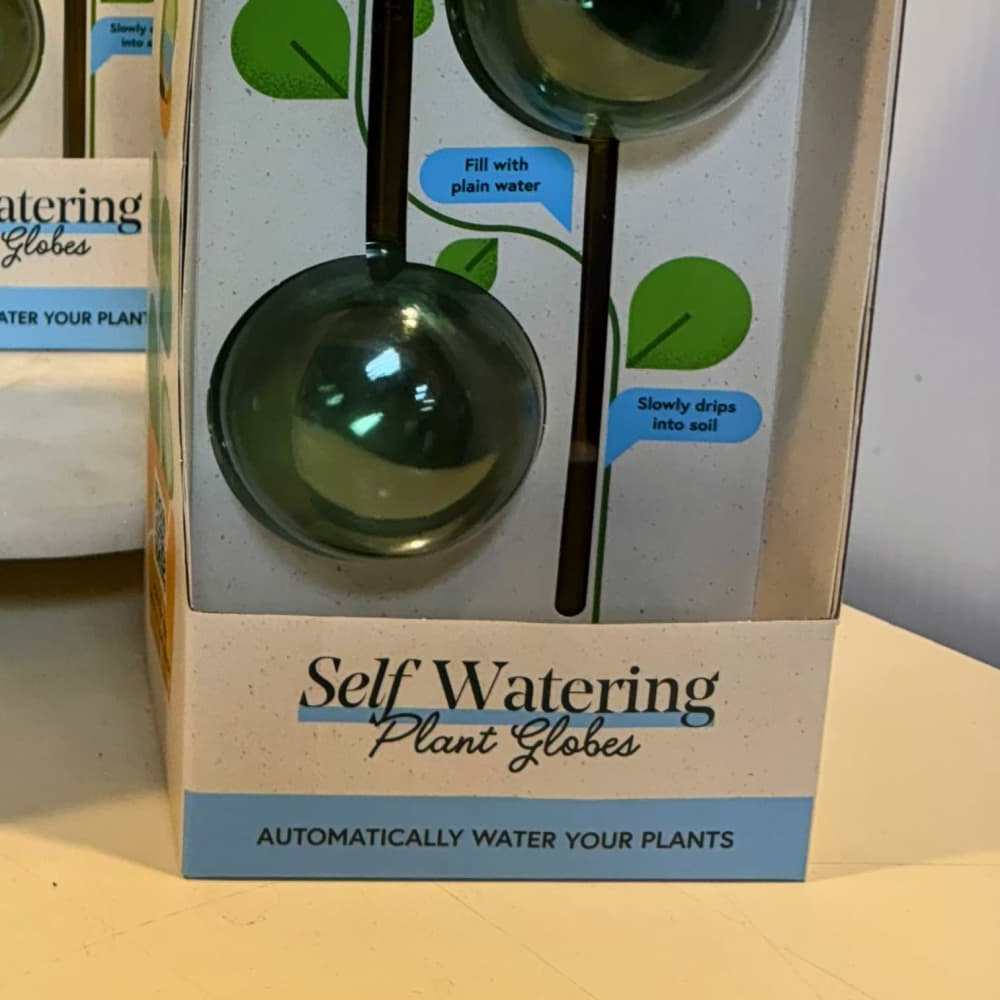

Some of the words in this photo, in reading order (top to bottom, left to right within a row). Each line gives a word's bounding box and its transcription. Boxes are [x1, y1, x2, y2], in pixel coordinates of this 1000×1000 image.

[111, 22, 146, 36] Slowly
[122, 37, 144, 48] into
[464, 158, 489, 172] Fill
[494, 157, 529, 172] with
[451, 179, 490, 196] plain
[494, 180, 541, 193] water
[0, 224, 91, 268] Globes
[43, 311, 92, 325] YOUR
[97, 311, 147, 326] PLAN
[637, 397, 691, 415] Slowly
[694, 398, 737, 416] drips
[652, 417, 685, 431] into
[689, 418, 718, 432] soil
[300, 656, 422, 726] Self
[432, 659, 720, 728] Watering
[368, 711, 498, 758] Plant
[508, 716, 642, 774] Globes
[256, 827, 466, 848] AUTOMATICALLY
[473, 828, 556, 849] WATER
[566, 830, 634, 851] YOUR
[641, 830, 734, 850] PLANTS
